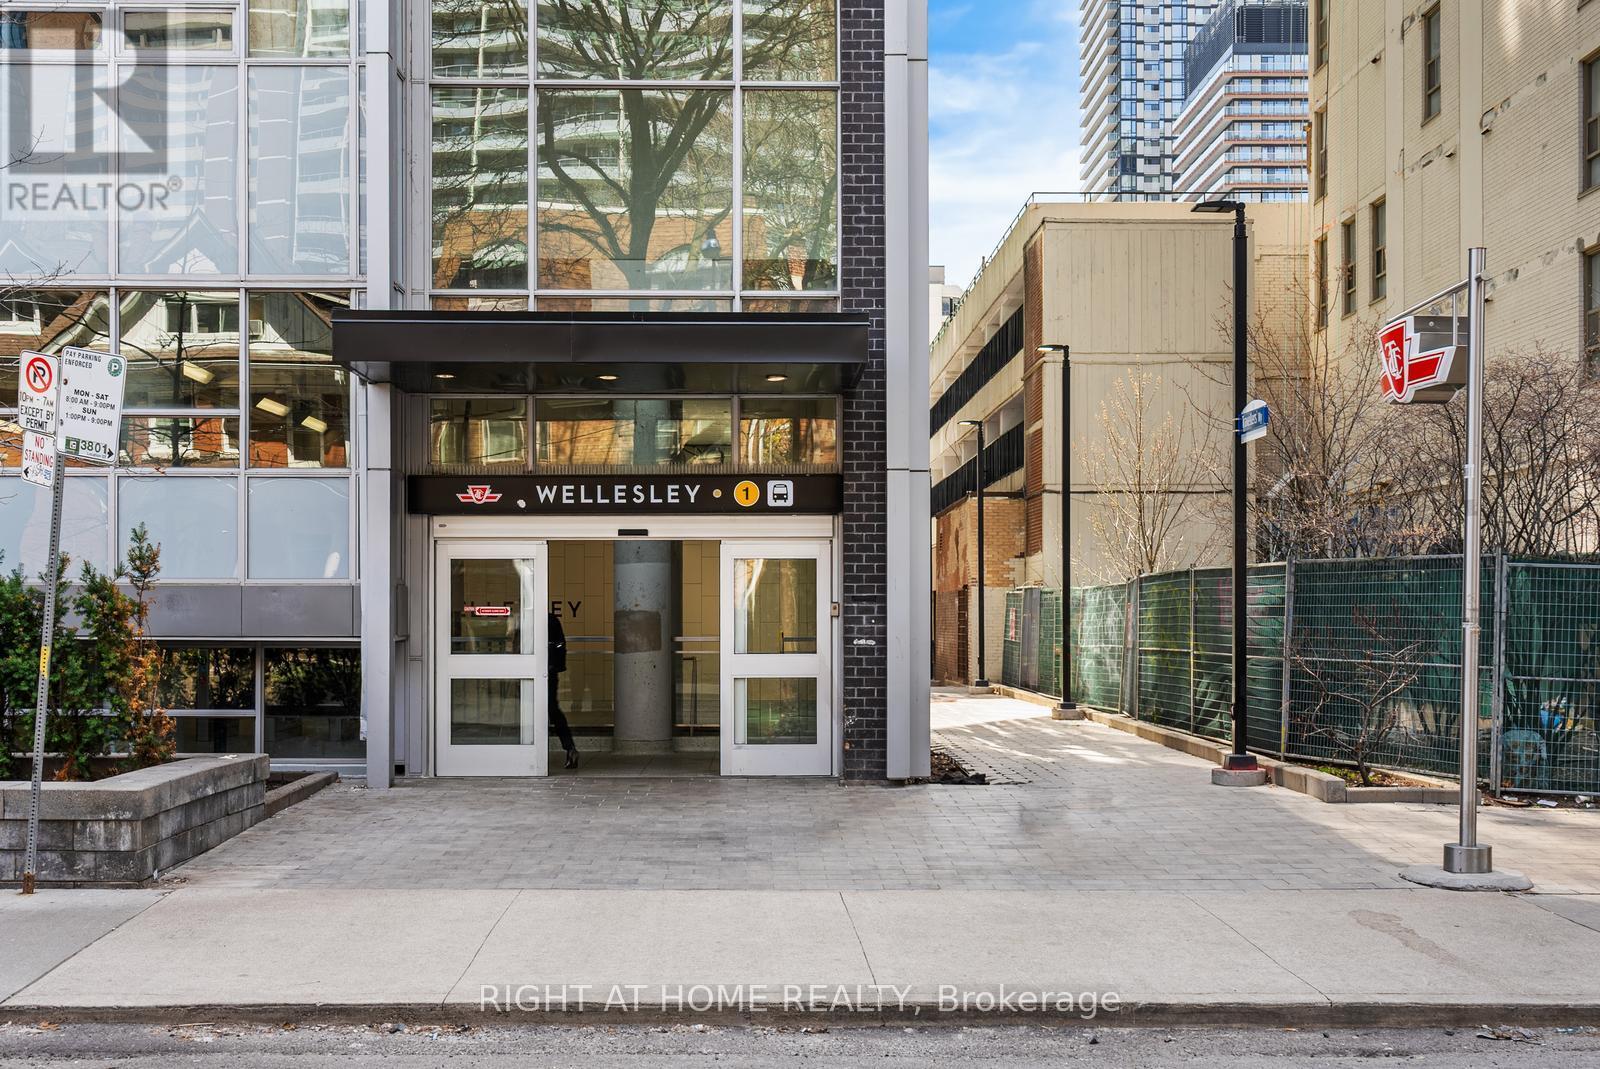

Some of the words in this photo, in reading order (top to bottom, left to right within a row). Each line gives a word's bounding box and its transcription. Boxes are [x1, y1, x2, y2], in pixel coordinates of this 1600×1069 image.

[64, 358, 93, 369] ENFORCED
[65, 350, 77, 358] PAY
[77, 352, 102, 363] PARKING
[43, 395, 54, 407] 7AM
[73, 388, 90, 398] MON
[95, 392, 109, 401] SAT
[65, 395, 78, 404] 8:00
[79, 398, 89, 406] AM
[93, 400, 116, 410] 9:00PM
[20, 404, 43, 419] EXCEPT
[46, 410, 55, 421] BY
[82, 406, 97, 415] SUN
[25, 417, 48, 432] PERMIT
[65, 412, 87, 421] 1:00PM
[91, 417, 113, 427] 9:00PM
[34, 435, 45, 450] NO
[80, 439, 108, 455] 3801
[24, 448, 54, 468] STANDING
[535, 484, 701, 504] WELLESLEY
